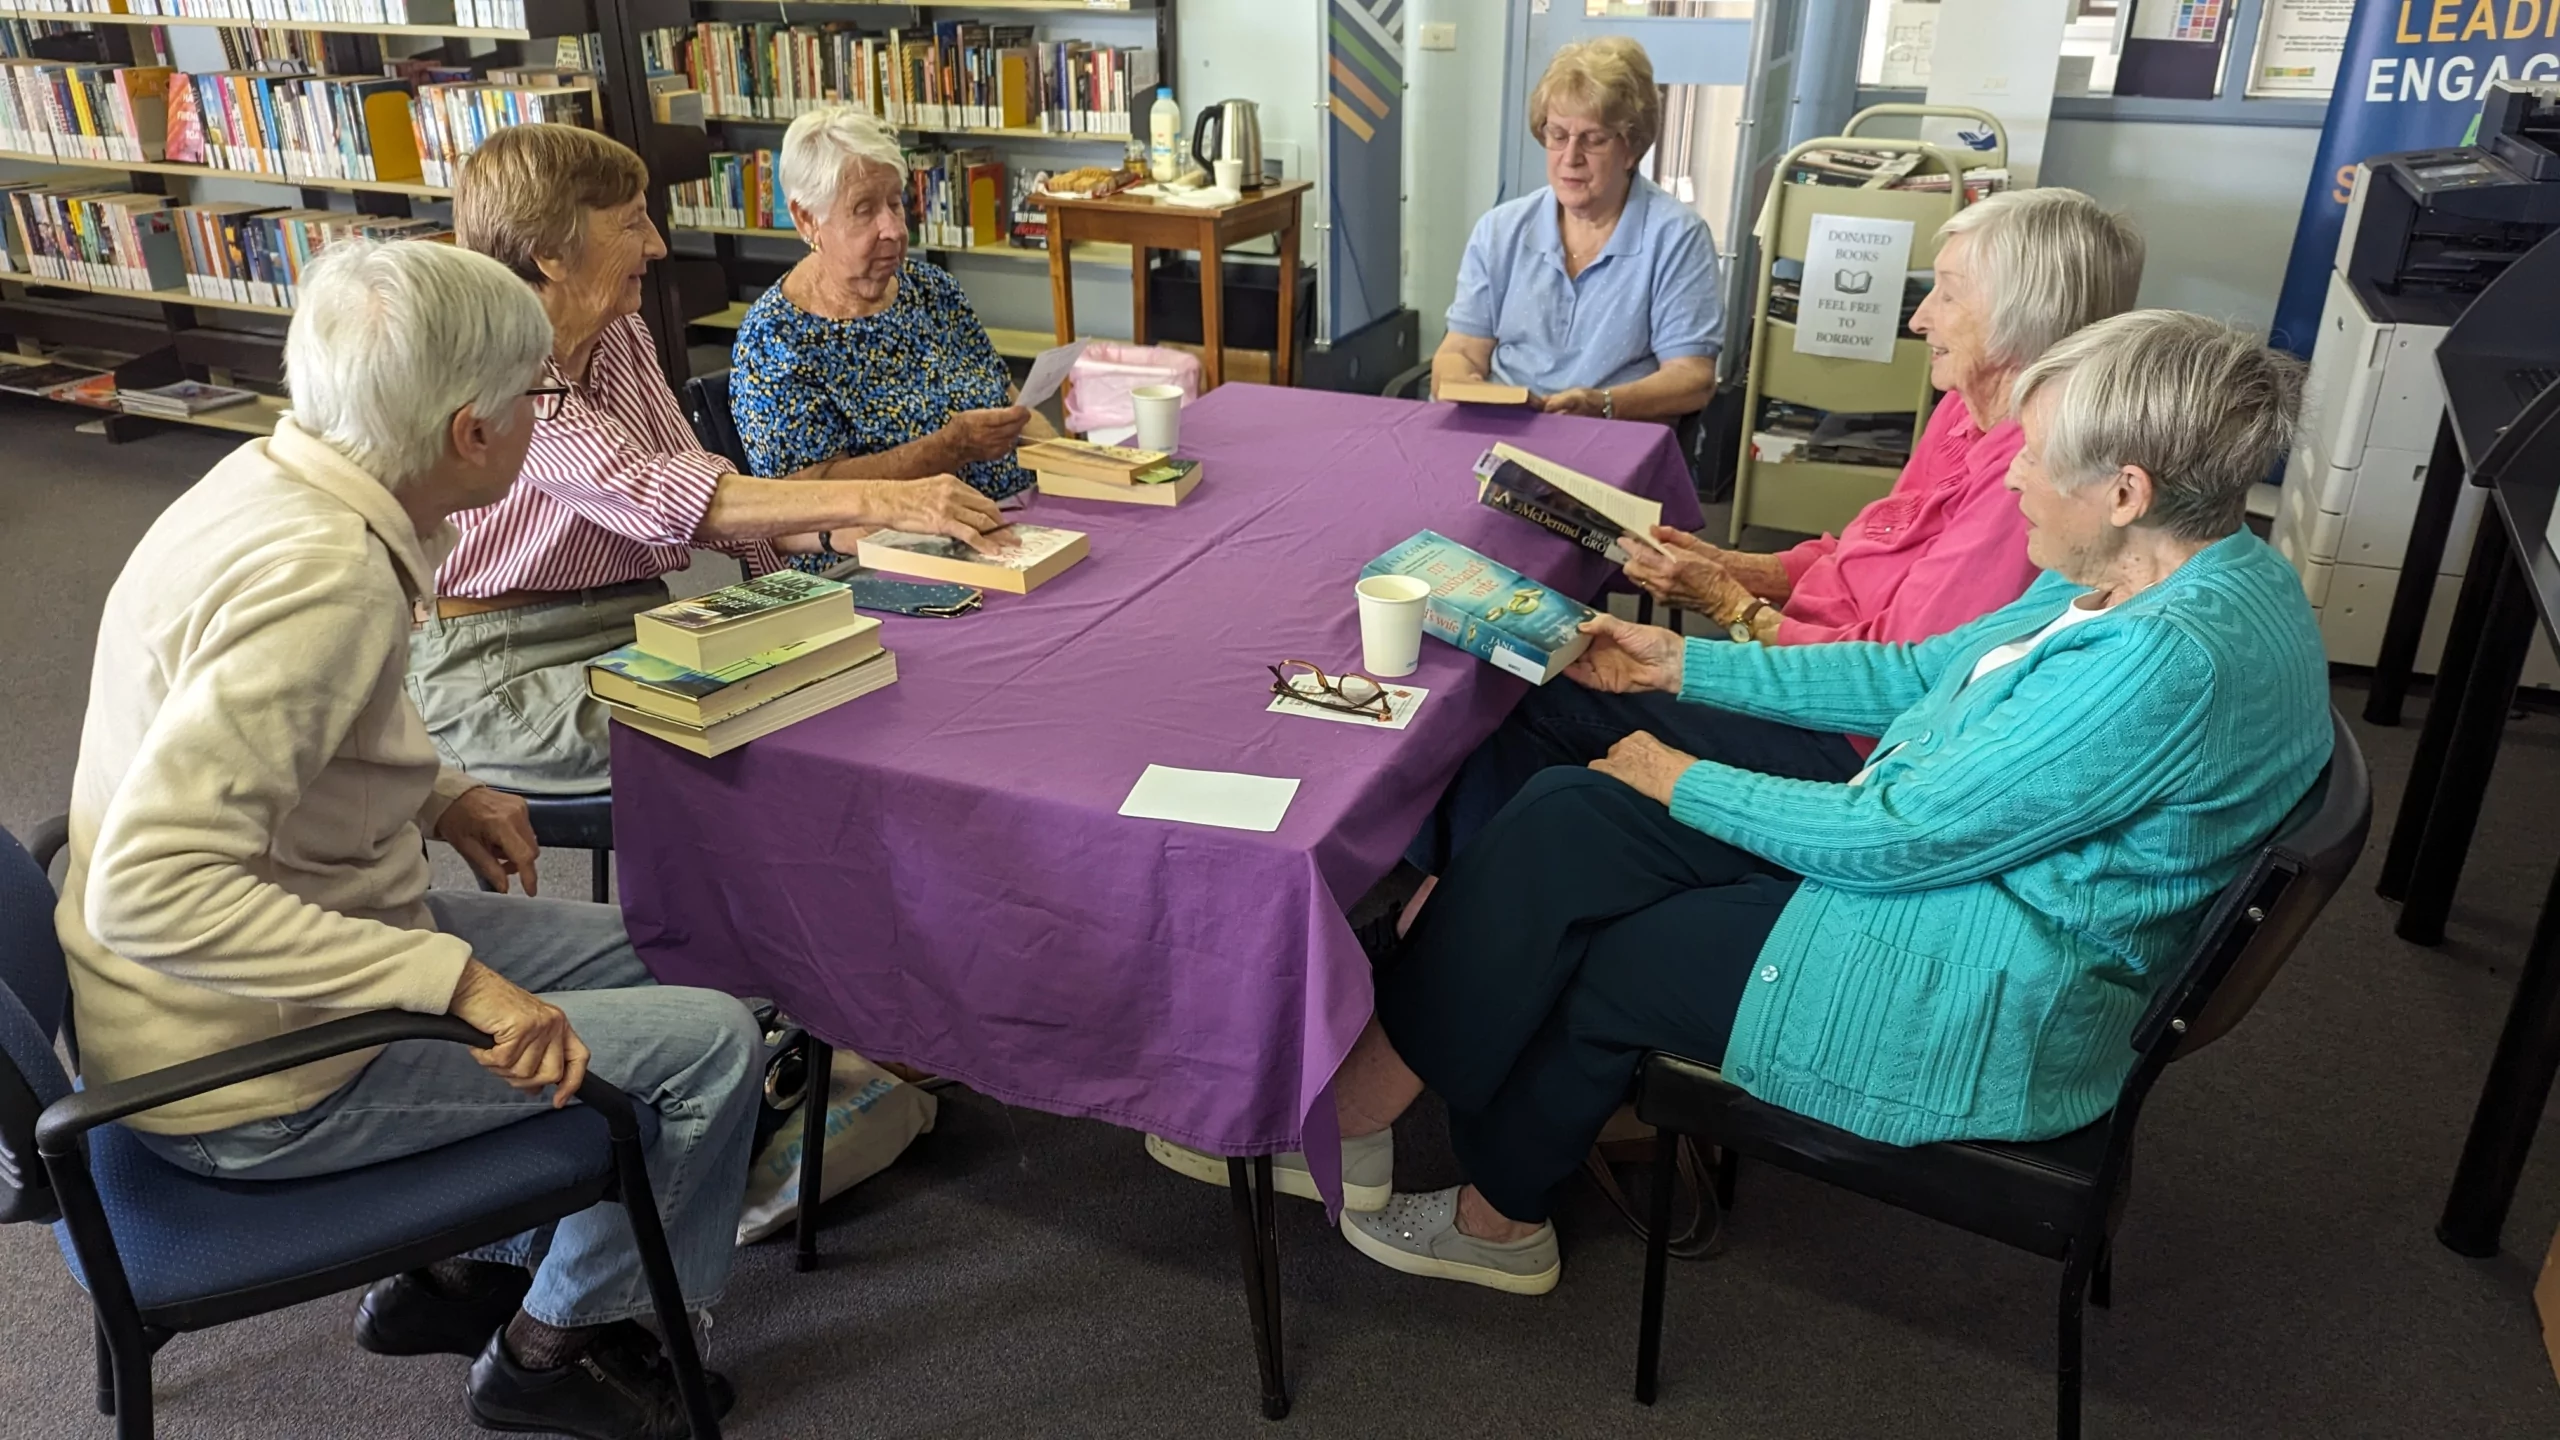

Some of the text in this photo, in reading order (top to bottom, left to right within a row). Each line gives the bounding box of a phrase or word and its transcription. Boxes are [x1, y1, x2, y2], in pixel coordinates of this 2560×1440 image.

[1828, 230, 1892, 246] DONATED
[1835, 248, 1879, 262] BOOKS
[1818, 298, 1881, 314] FEEL FREE
[1838, 317, 1856, 328] TO
[1816, 331, 1874, 347] BORROW
[1519, 502, 1581, 539] McDermid
[1581, 536, 1606, 554] GRO
[1469, 578, 1499, 598] wife
[1435, 616, 1459, 634] wife
[1488, 636, 1516, 652] JANE
[848, 1079, 894, 1114] BAG
